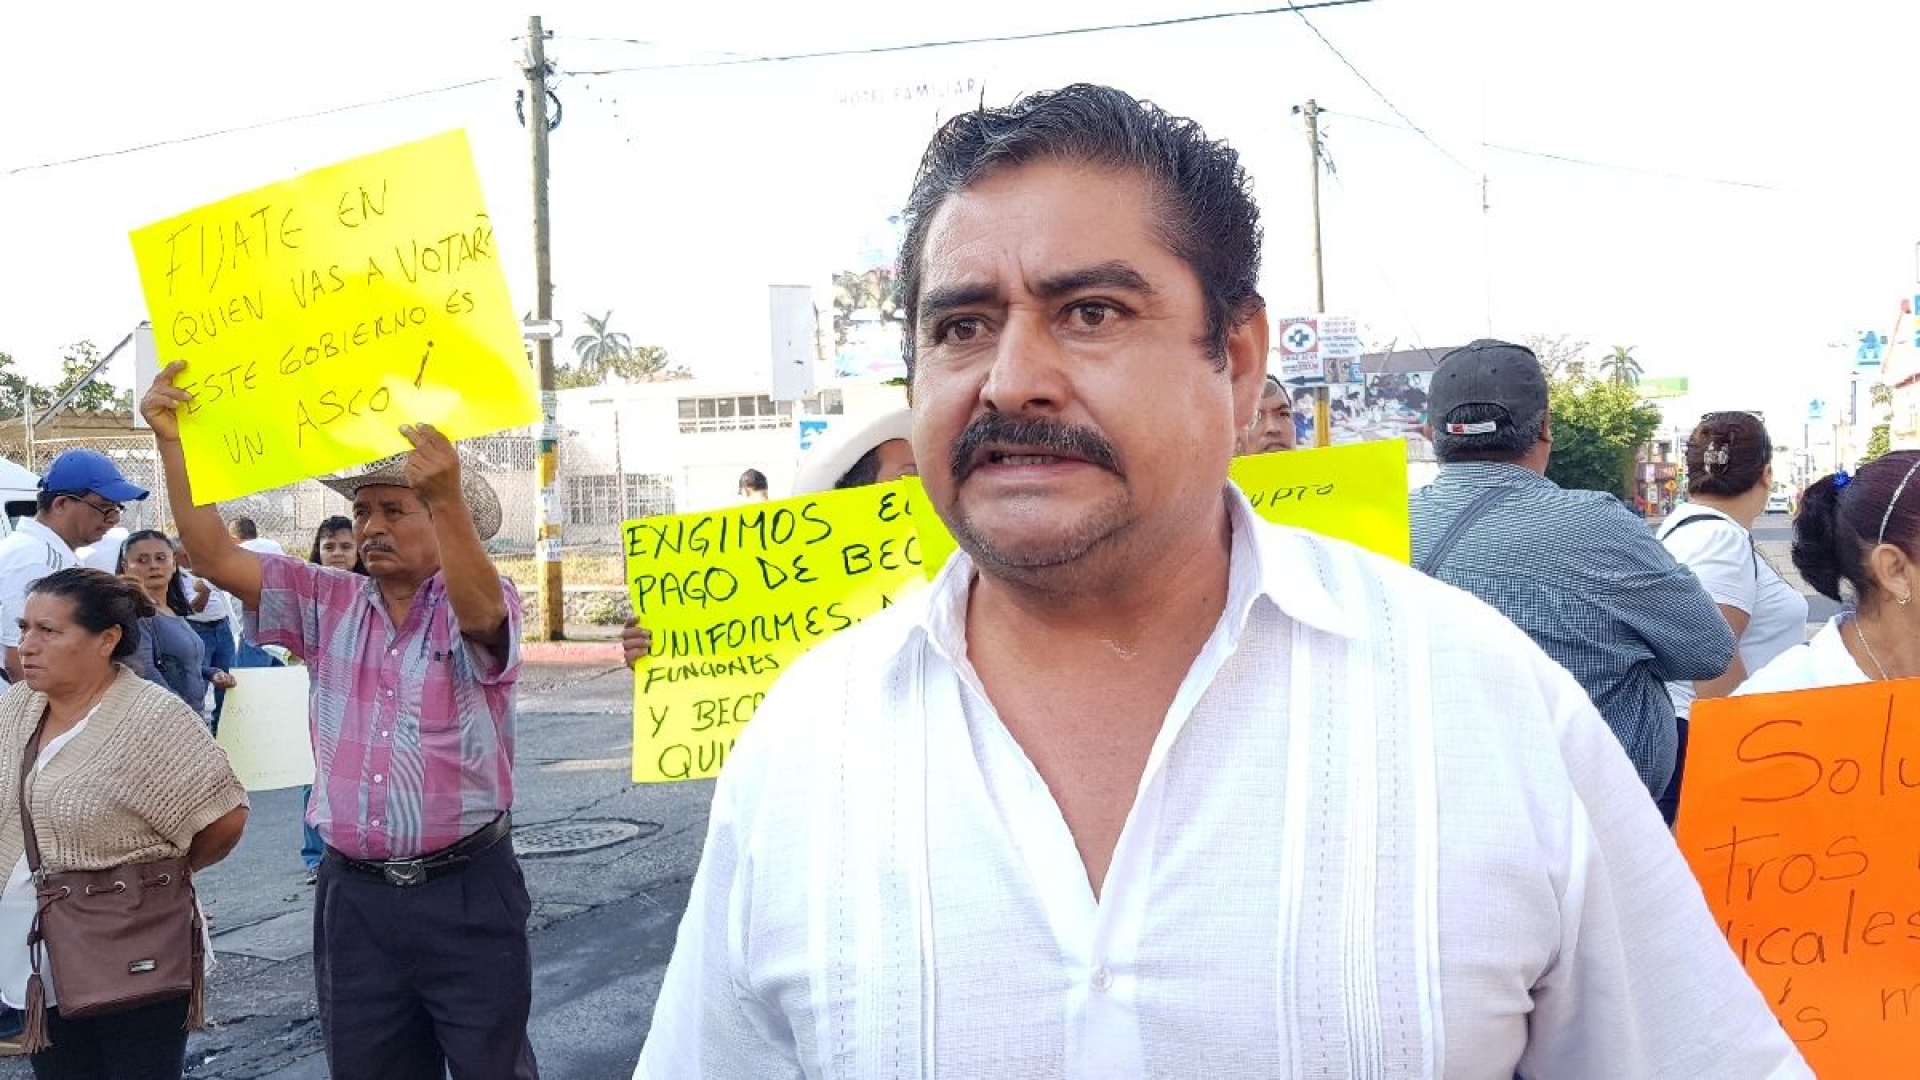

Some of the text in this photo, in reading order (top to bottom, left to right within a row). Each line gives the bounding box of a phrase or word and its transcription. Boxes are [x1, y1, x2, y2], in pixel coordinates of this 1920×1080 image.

[338, 179, 387, 228] EN
[172, 290, 264, 347] QUIEN
[291, 265, 345, 309] VAS
[366, 257, 384, 286] A
[181, 291, 475, 414] ESTE GOBIERNO ES
[221, 430, 265, 465] UN
[298, 386, 391, 448] ASCO
[627, 502, 832, 559] EXIGIMOS
[634, 566, 738, 615] PAGO
[757, 555, 818, 589] DE
[650, 706, 669, 737] Y
[658, 739, 735, 778] QUI
[1725, 889, 1920, 967] icales
